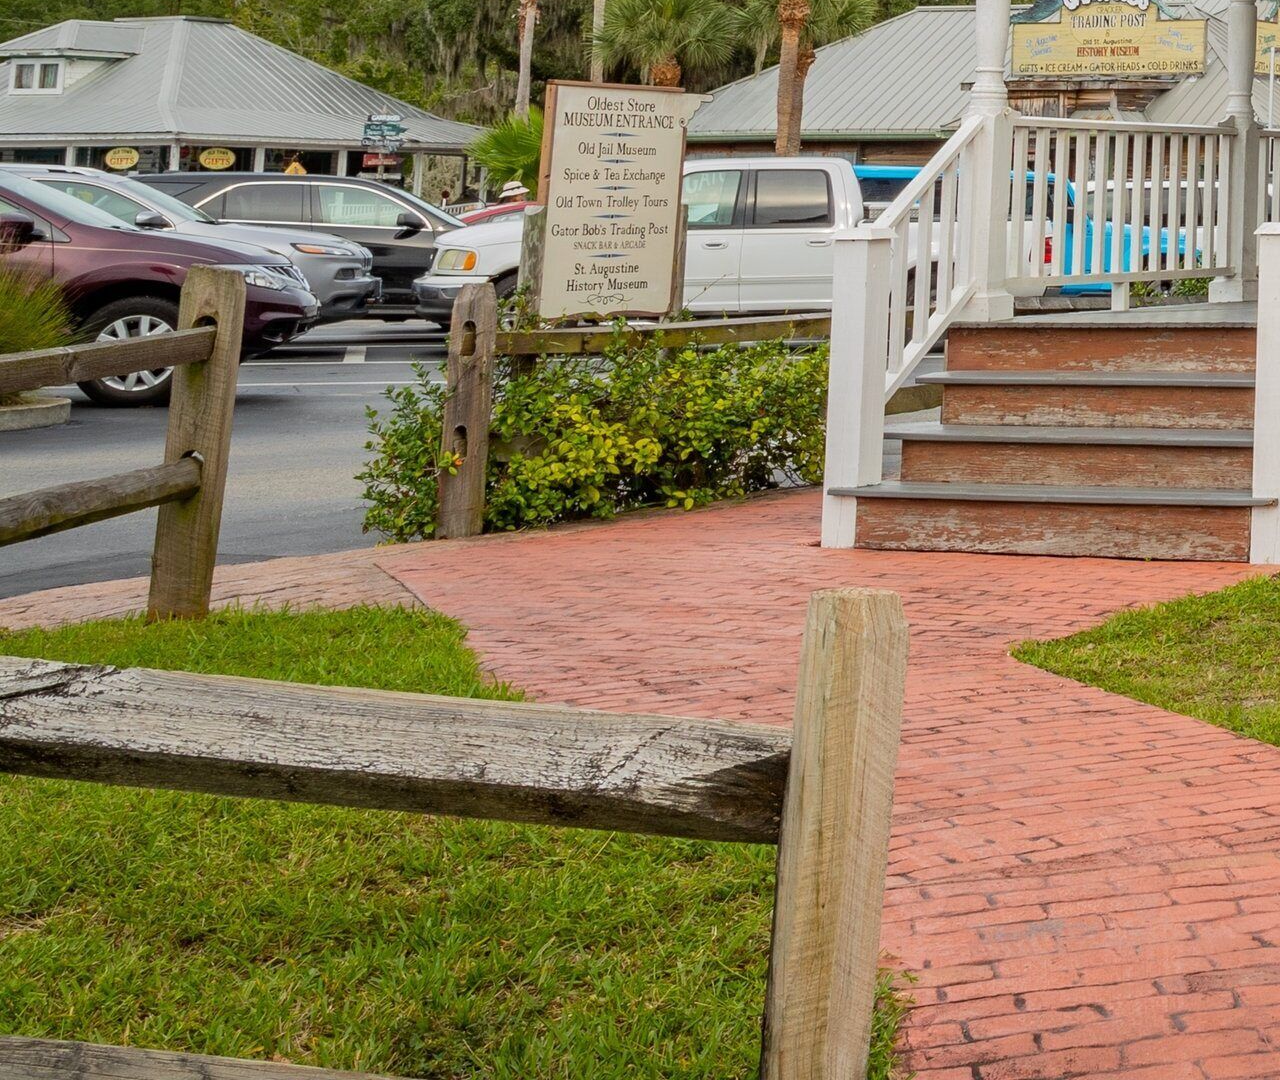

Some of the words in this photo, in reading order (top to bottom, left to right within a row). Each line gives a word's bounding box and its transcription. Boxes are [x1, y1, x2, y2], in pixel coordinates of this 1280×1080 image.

[1071, 14, 1116, 29] TRADING
[1120, 13, 1147, 27] POST
[1102, 38, 1133, 46] Augustine
[1076, 46, 1108, 57] HISTORY
[1110, 46, 1140, 57] MUSEUM
[1018, 63, 1039, 73] GIFTS
[1045, 63, 1056, 73] ICE
[1057, 62, 1083, 73] CREAM
[1089, 62, 1114, 72] GATOR
[1116, 62, 1141, 72] HEADS
[1147, 61, 1168, 71] COLD
[1169, 60, 1199, 71] DRINKS
[587, 95, 624, 112] Oldest
[627, 97, 656, 113] Store
[563, 112, 614, 128] MUSEUM
[615, 114, 675, 129] ENTRANCE
[578, 141, 596, 155] Old
[597, 142, 614, 159] Jail
[616, 142, 657, 156] Museum
[109, 157, 135, 166] GIFTS
[203, 157, 231, 166] GIFTS
[563, 167, 590, 184] Spice
[592, 169, 600, 180] &
[604, 168, 620, 181] Tea
[622, 168, 666, 185] Exchange
[555, 195, 573, 208] Old
[576, 195, 603, 208] Town
[606, 195, 639, 212] Trolley
[642, 194, 669, 207] Tours
[551, 224, 580, 237] Gator
[582, 223, 606, 236] Bob's
[610, 222, 646, 239] Trading
[648, 222, 669, 235] Post
[573, 241, 597, 250] SNACK
[598, 241, 612, 250] BAR
[619, 240, 647, 249] ARCADE
[574, 262, 587, 275] St.
[589, 261, 640, 279] Augustine
[566, 279, 604, 295] History
[607, 278, 648, 291] Museum
